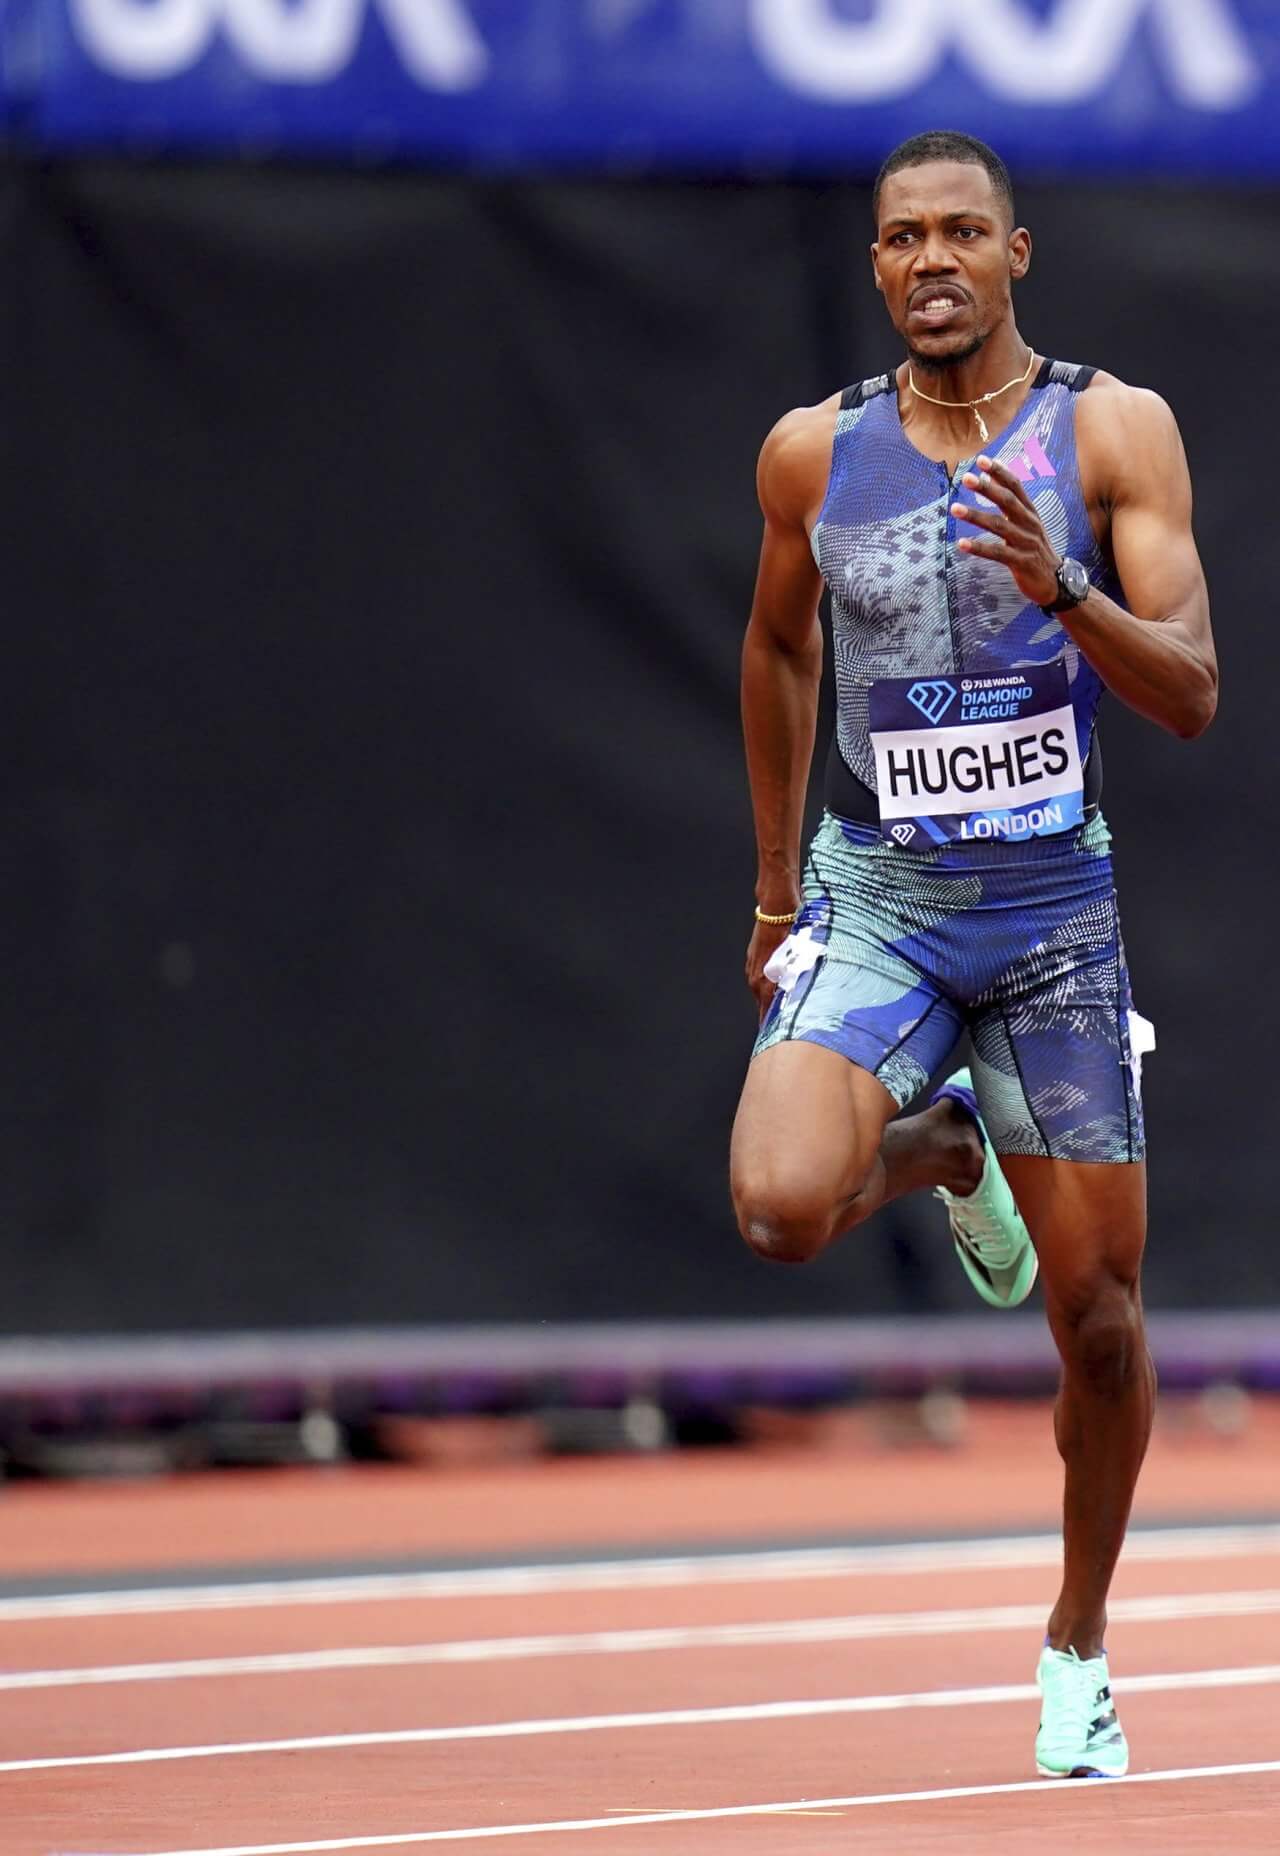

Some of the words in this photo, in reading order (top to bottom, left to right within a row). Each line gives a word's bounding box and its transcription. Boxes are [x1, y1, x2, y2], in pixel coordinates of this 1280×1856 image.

[992, 676, 1026, 687] WANDA
[961, 686, 1033, 706] DIAMOND
[960, 702, 1020, 721] LEAGUE
[887, 728, 1070, 797] HUGHES
[960, 804, 1063, 841] LONDON
